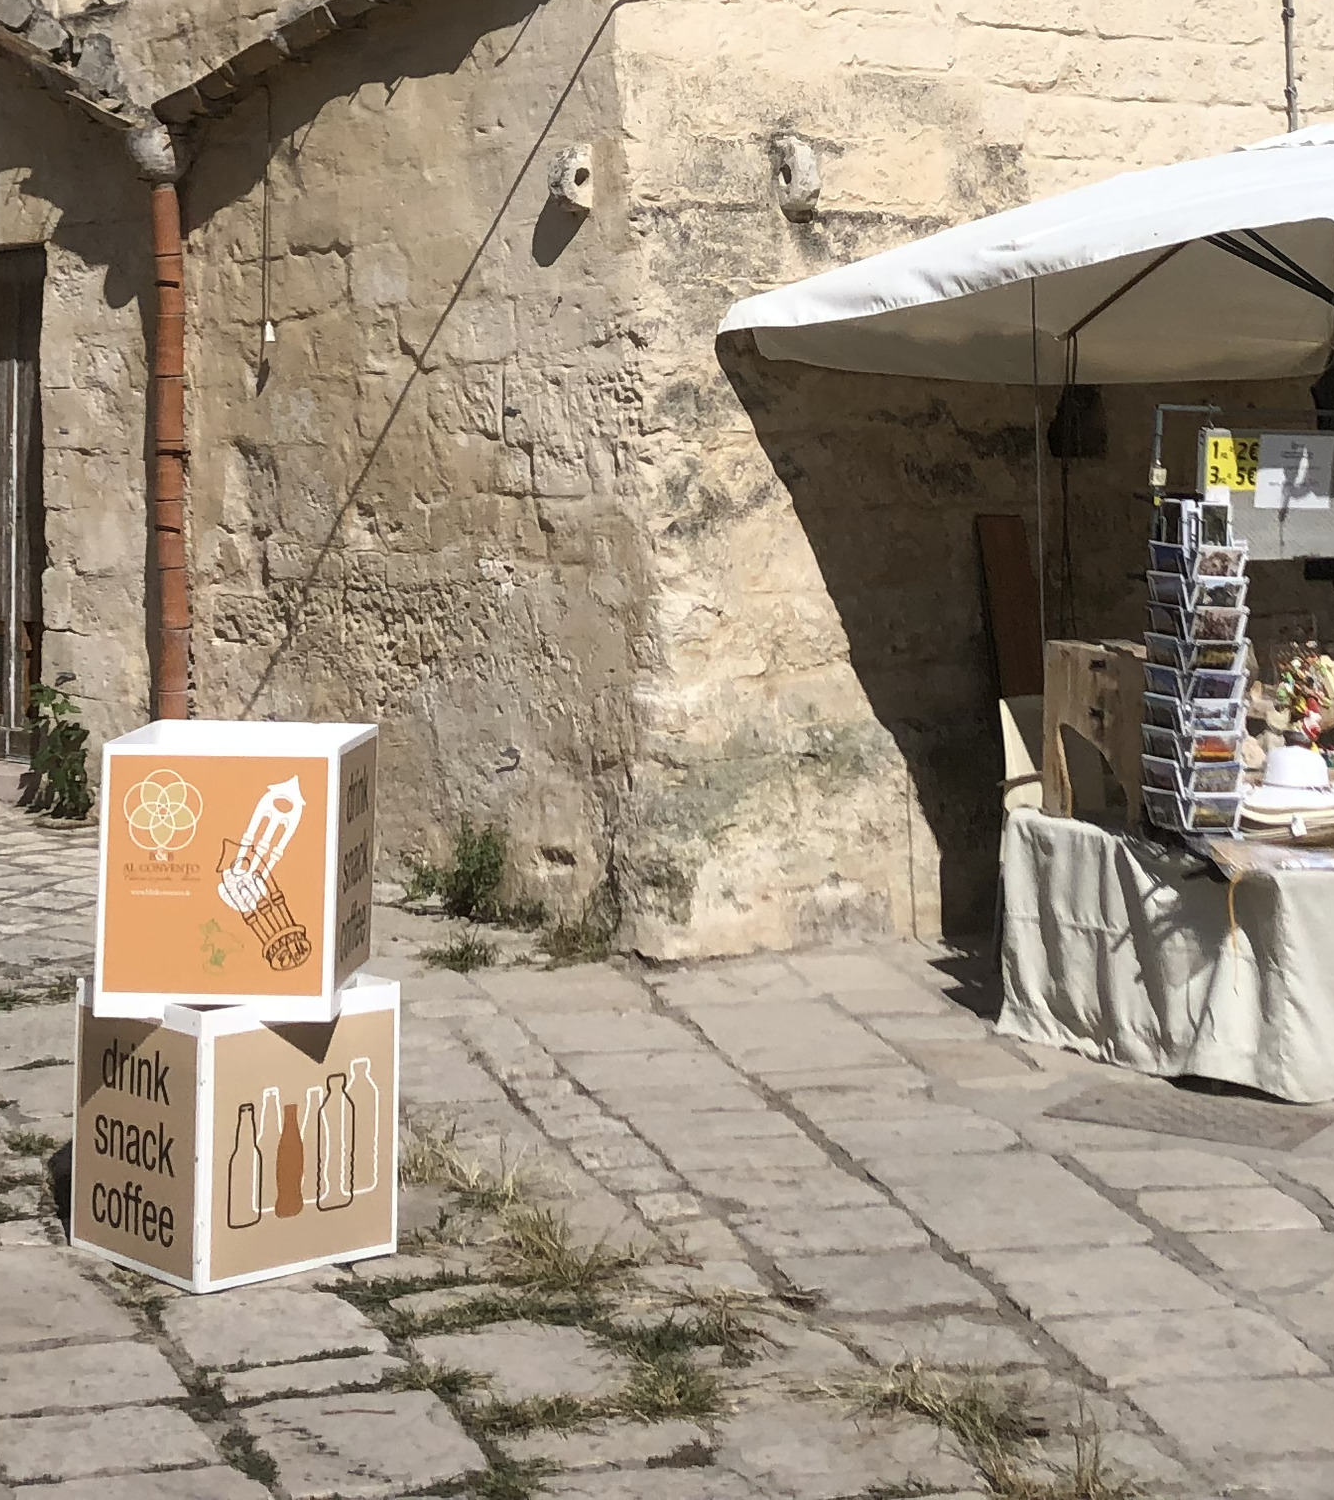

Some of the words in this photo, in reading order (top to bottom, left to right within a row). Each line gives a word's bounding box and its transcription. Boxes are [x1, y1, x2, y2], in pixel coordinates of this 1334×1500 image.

[1209, 465, 1219, 485] 3
[1212, 440, 1219, 460] 1
[102, 1038, 171, 1106] drink
[94, 1113, 175, 1179] snack
[92, 1180, 174, 1248] coffee
